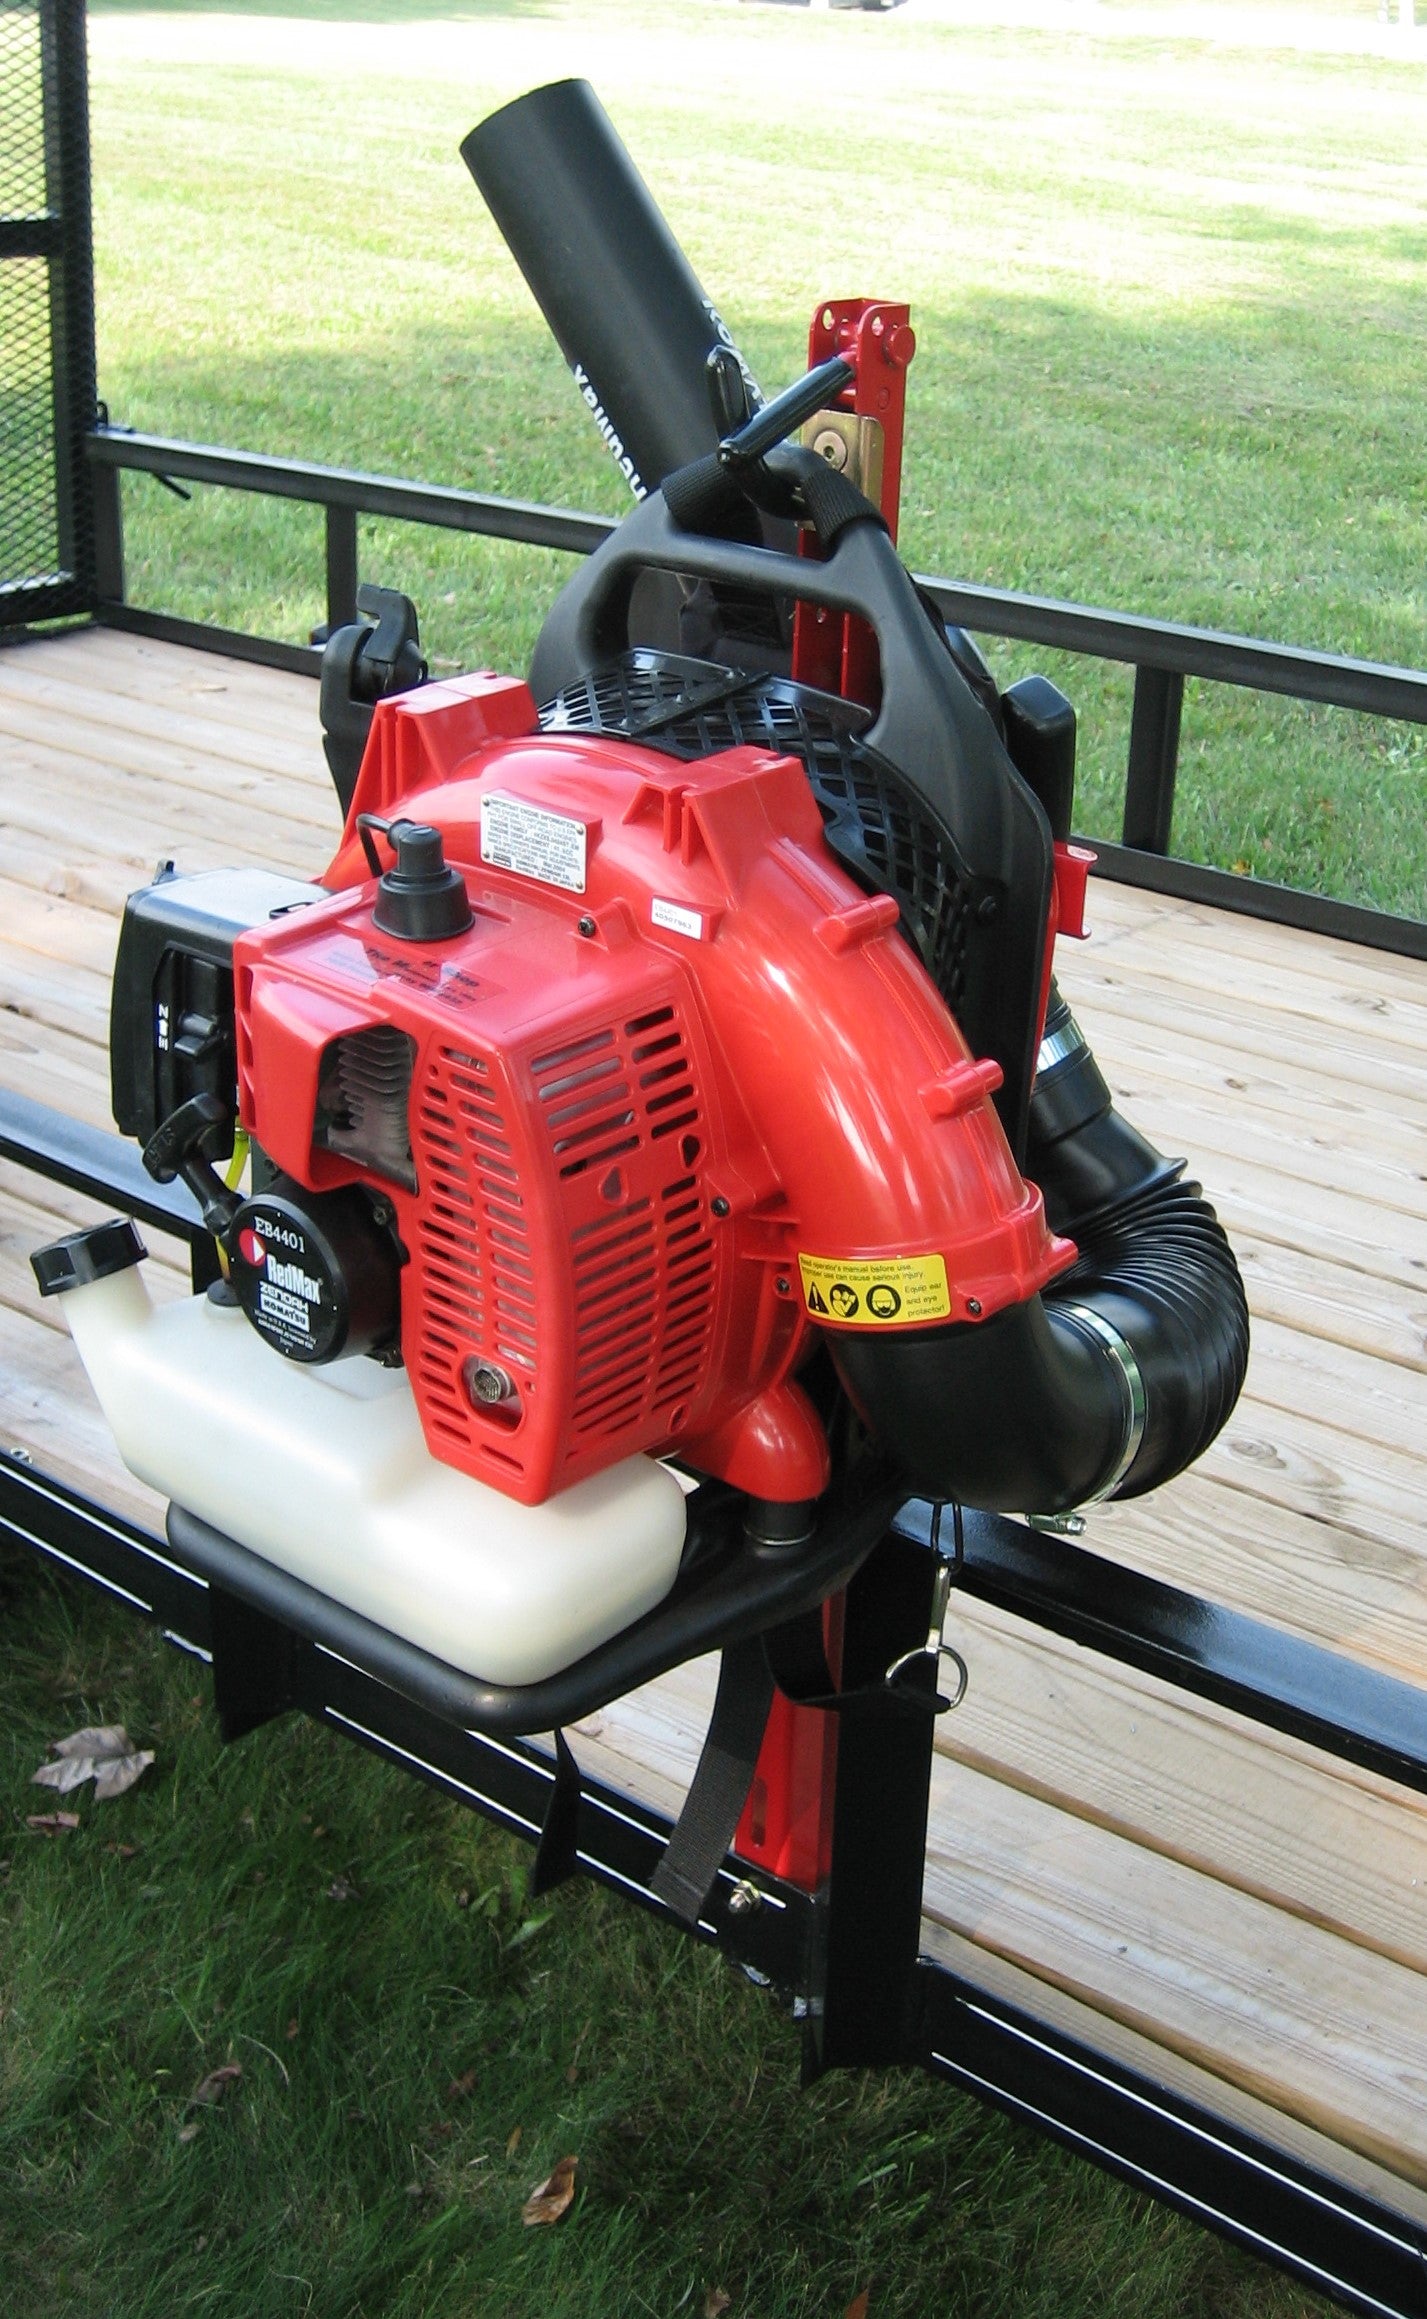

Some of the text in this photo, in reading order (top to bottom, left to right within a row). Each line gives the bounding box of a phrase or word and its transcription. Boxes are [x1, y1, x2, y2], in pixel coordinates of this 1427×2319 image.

[254, 1215, 305, 1254] EB4401
[260, 1280, 309, 1314] ZENOAH
[267, 1253, 320, 1306] RedMax
[263, 1299, 307, 1326] KOMATSU
